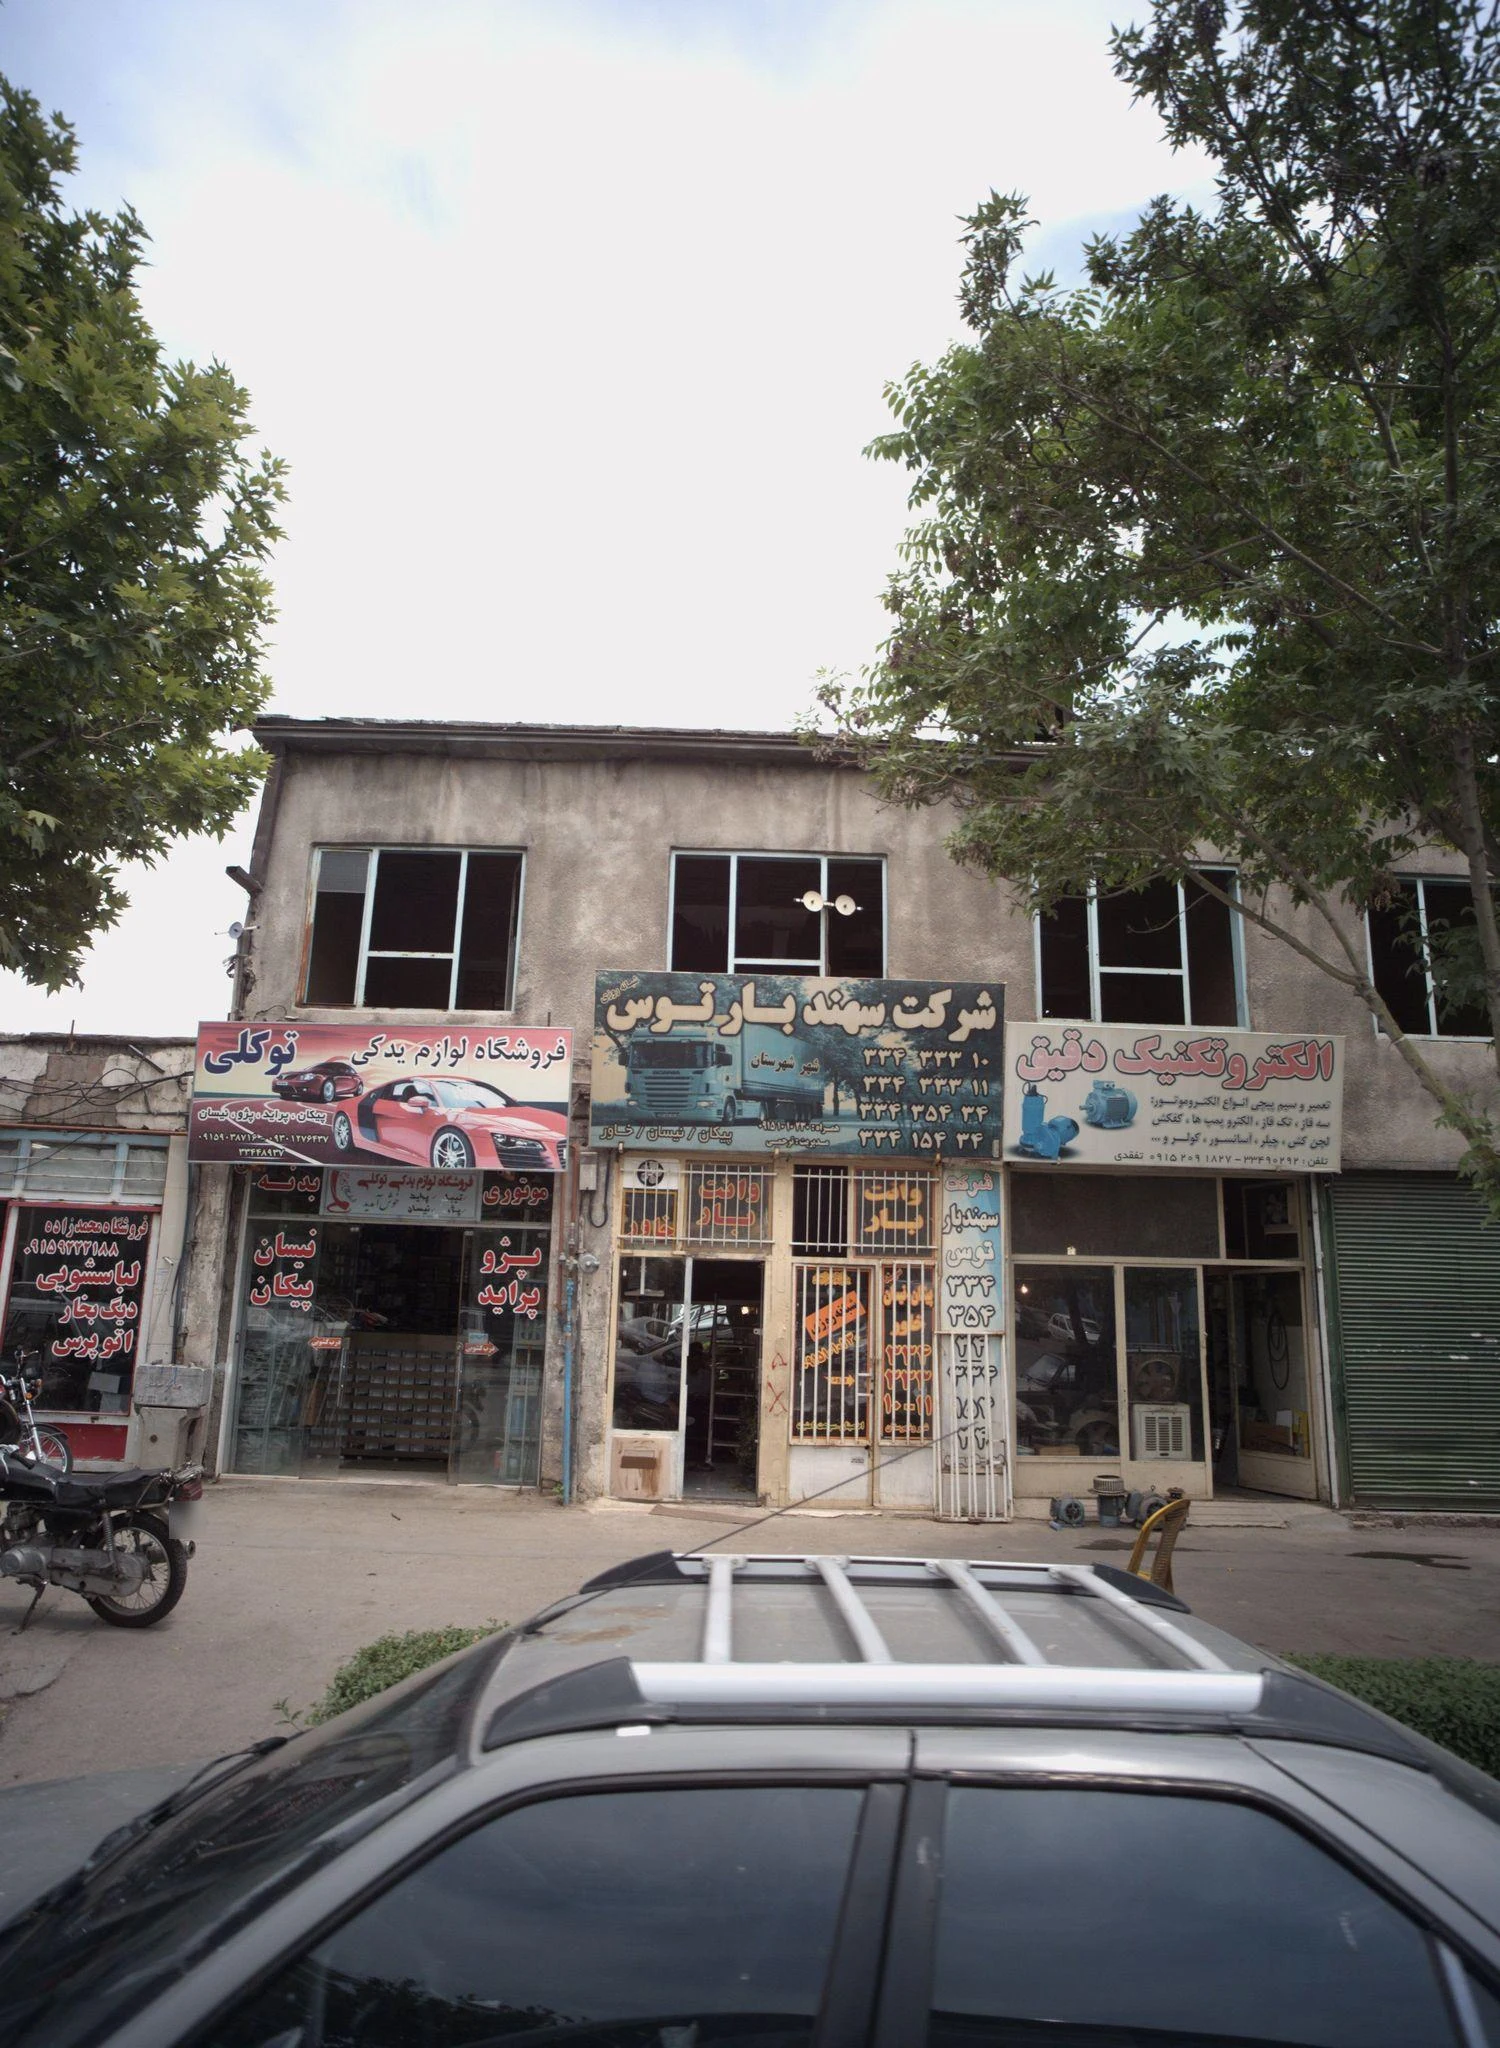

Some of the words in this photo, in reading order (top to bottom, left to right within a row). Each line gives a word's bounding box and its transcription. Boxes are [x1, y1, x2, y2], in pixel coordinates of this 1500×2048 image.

[606, 980, 716, 1034] توس
[718, 980, 796, 1036] بار
[803, 988, 886, 1036] سهند
[893, 988, 997, 1042] شرکت
[203, 1028, 299, 1076] توکلی
[351, 1035, 406, 1065] یدکی
[414, 1037, 467, 1067] لوازم
[474, 1037, 566, 1069] فروشگاه
[863, 1048, 906, 1067] ۳۳۴
[919, 1050, 962, 1068] ۳۳۳
[972, 1052, 990, 1069] ۱۰
[1017, 1029, 1107, 1081] دقیق
[863, 1075, 906, 1094] ۳۳۴
[919, 1077, 962, 1096] ۳۳۳
[972, 1079, 989, 1097] ۱۱
[198, 1107, 229, 1120] نیسان
[858, 1103, 901, 1121] ۳۳۴
[911, 1104, 952, 1122] ۳۵۴
[960, 1105, 989, 1123] ۳۴
[1222, 1097, 1248, 1110] انواع
[1251, 1101, 1275, 1111] پیچی
[1277, 1103, 1297, 1111] سیم
[1299, 1103, 1305, 1112] و
[1307, 1100, 1331, 1112] تعمیر
[600, 1123, 634, 1140] خاور
[647, 1125, 685, 1142] نیسان
[1277, 1117, 1292, 1127] تک
[1315, 1120, 1330, 1128] سه
[698, 1126, 733, 1145] پیکان
[858, 1130, 902, 1148] ۳۳۴
[912, 1131, 948, 1149] ۱۵۴
[956, 1132, 984, 1150] ۳۴
[1310, 1136, 1330, 1149] لجن
[357, 1173, 388, 1191] توکلی
[417, 1175, 436, 1191] لوازم
[437, 1175, 474, 1192] فروشگاه
[483, 1177, 549, 1205] موتوری
[945, 1172, 994, 1198] شرکت
[103, 1215, 149, 1240] فروشگاه
[254, 1228, 317, 1269] نیسان
[480, 1236, 542, 1280] پژو
[946, 1240, 995, 1269] توس
[36, 1257, 141, 1293] لباسشویی
[946, 1275, 996, 1297] ۳۳۴
[250, 1272, 314, 1312] پیکان
[478, 1279, 540, 1320] پراید
[59, 1294, 99, 1325] بخار
[100, 1296, 138, 1325] دیگ
[947, 1305, 996, 1327] ۳۵۴
[52, 1333, 99, 1360] پرس
[100, 1329, 134, 1359] اتو
